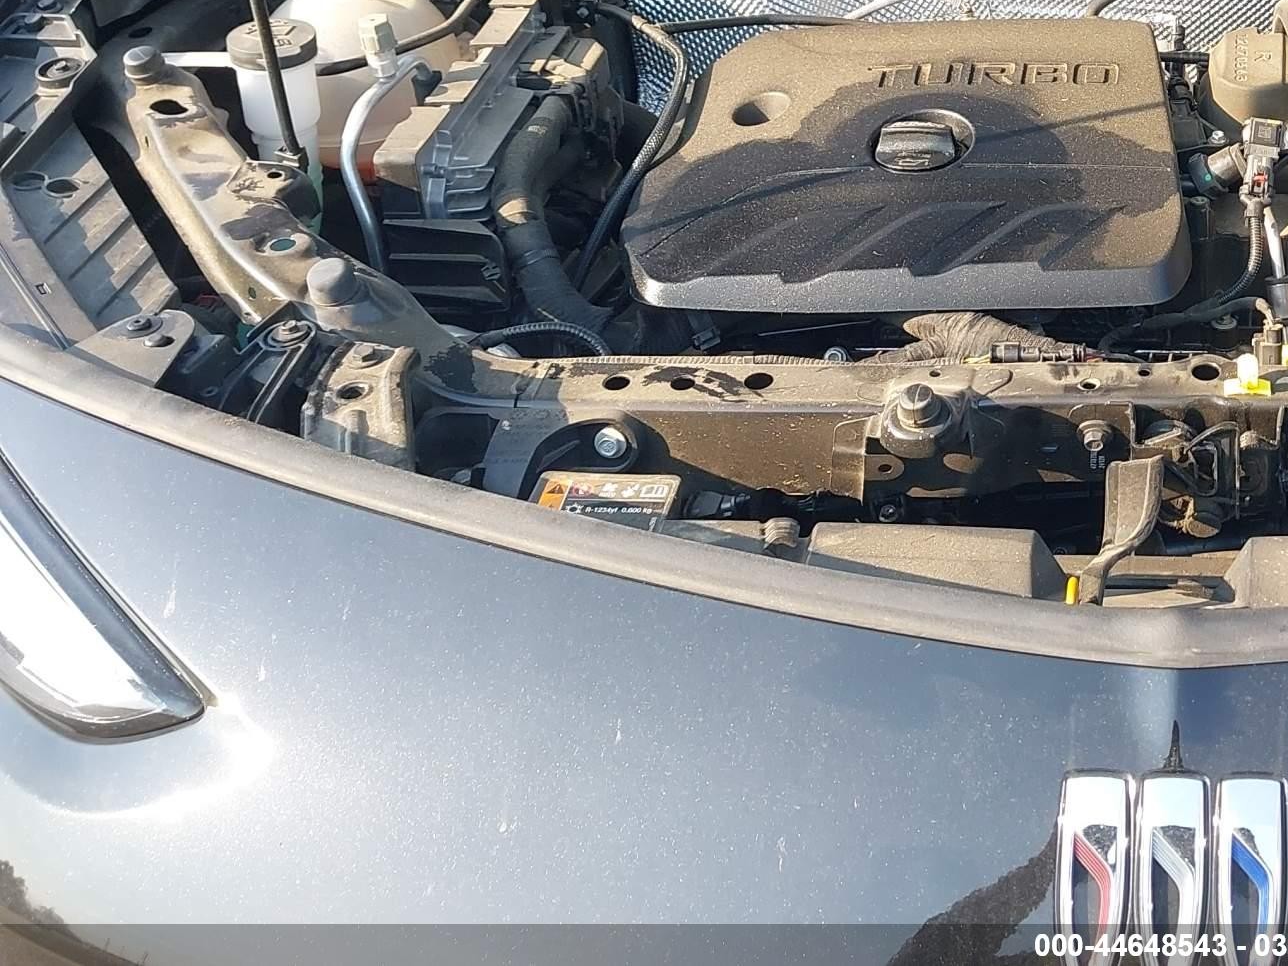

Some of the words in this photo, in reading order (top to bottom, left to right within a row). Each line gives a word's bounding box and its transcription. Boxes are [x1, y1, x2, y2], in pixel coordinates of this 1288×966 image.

[1254, 50, 1273, 62] R
[868, 60, 1120, 88] TURBO
[642, 506, 653, 515] kg
